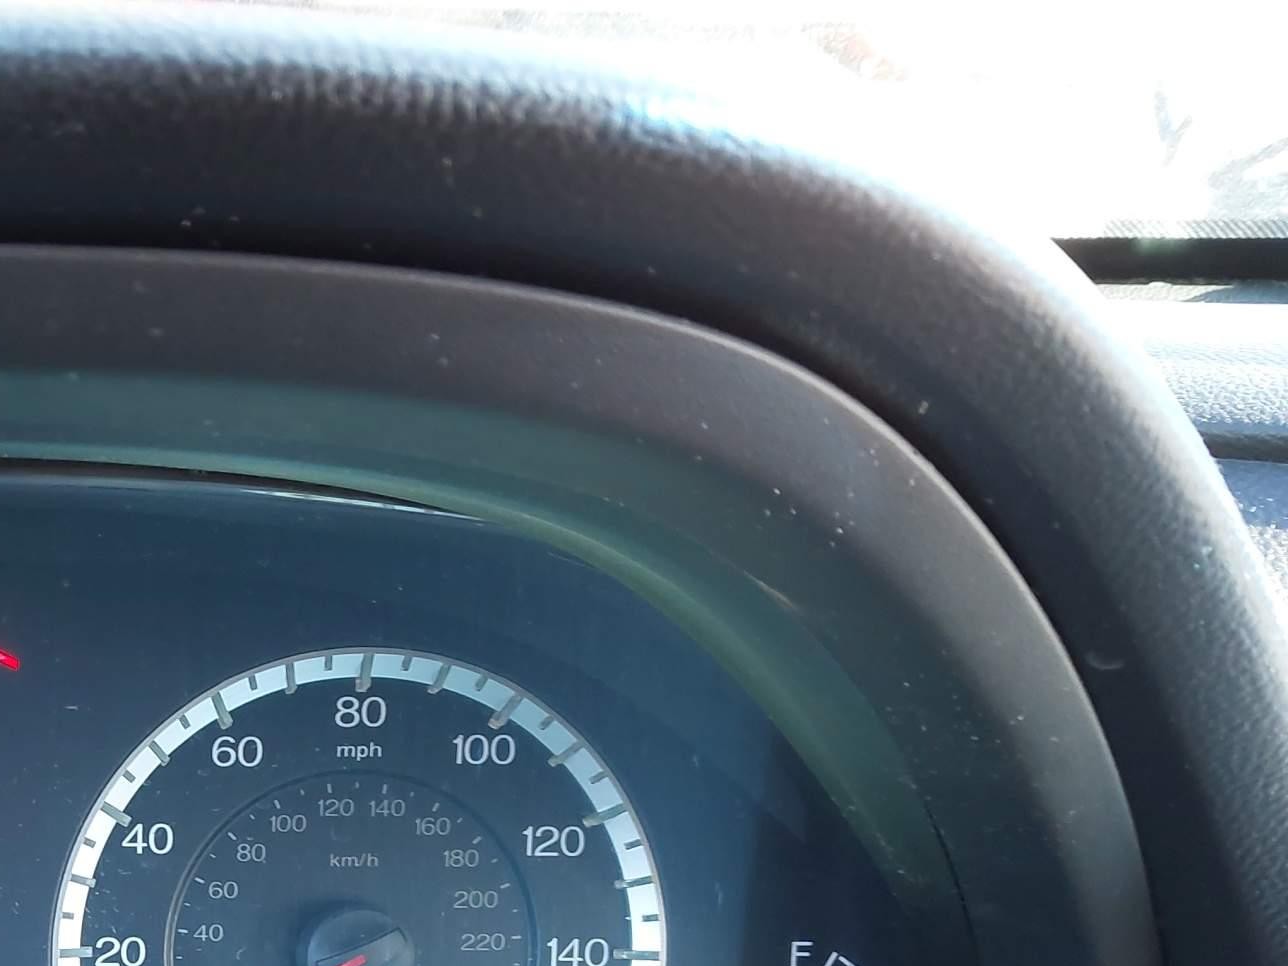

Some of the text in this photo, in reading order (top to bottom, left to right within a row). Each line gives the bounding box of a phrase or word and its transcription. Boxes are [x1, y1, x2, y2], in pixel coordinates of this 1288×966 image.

[335, 697, 386, 727] 80
[212, 737, 262, 766] 60
[336, 744, 383, 760] mph
[453, 735, 515, 764] 100
[318, 799, 354, 816] 120
[370, 800, 405, 816] 140
[270, 815, 306, 832] 100
[416, 818, 450, 835] 160
[121, 822, 174, 854] 40
[523, 827, 584, 856] 120
[237, 844, 265, 861] 80
[330, 854, 378, 867] km/h
[444, 850, 479, 867] 180
[209, 882, 238, 898] 60
[454, 891, 497, 908] 200
[194, 925, 223, 941] 40
[461, 933, 505, 950] 220
